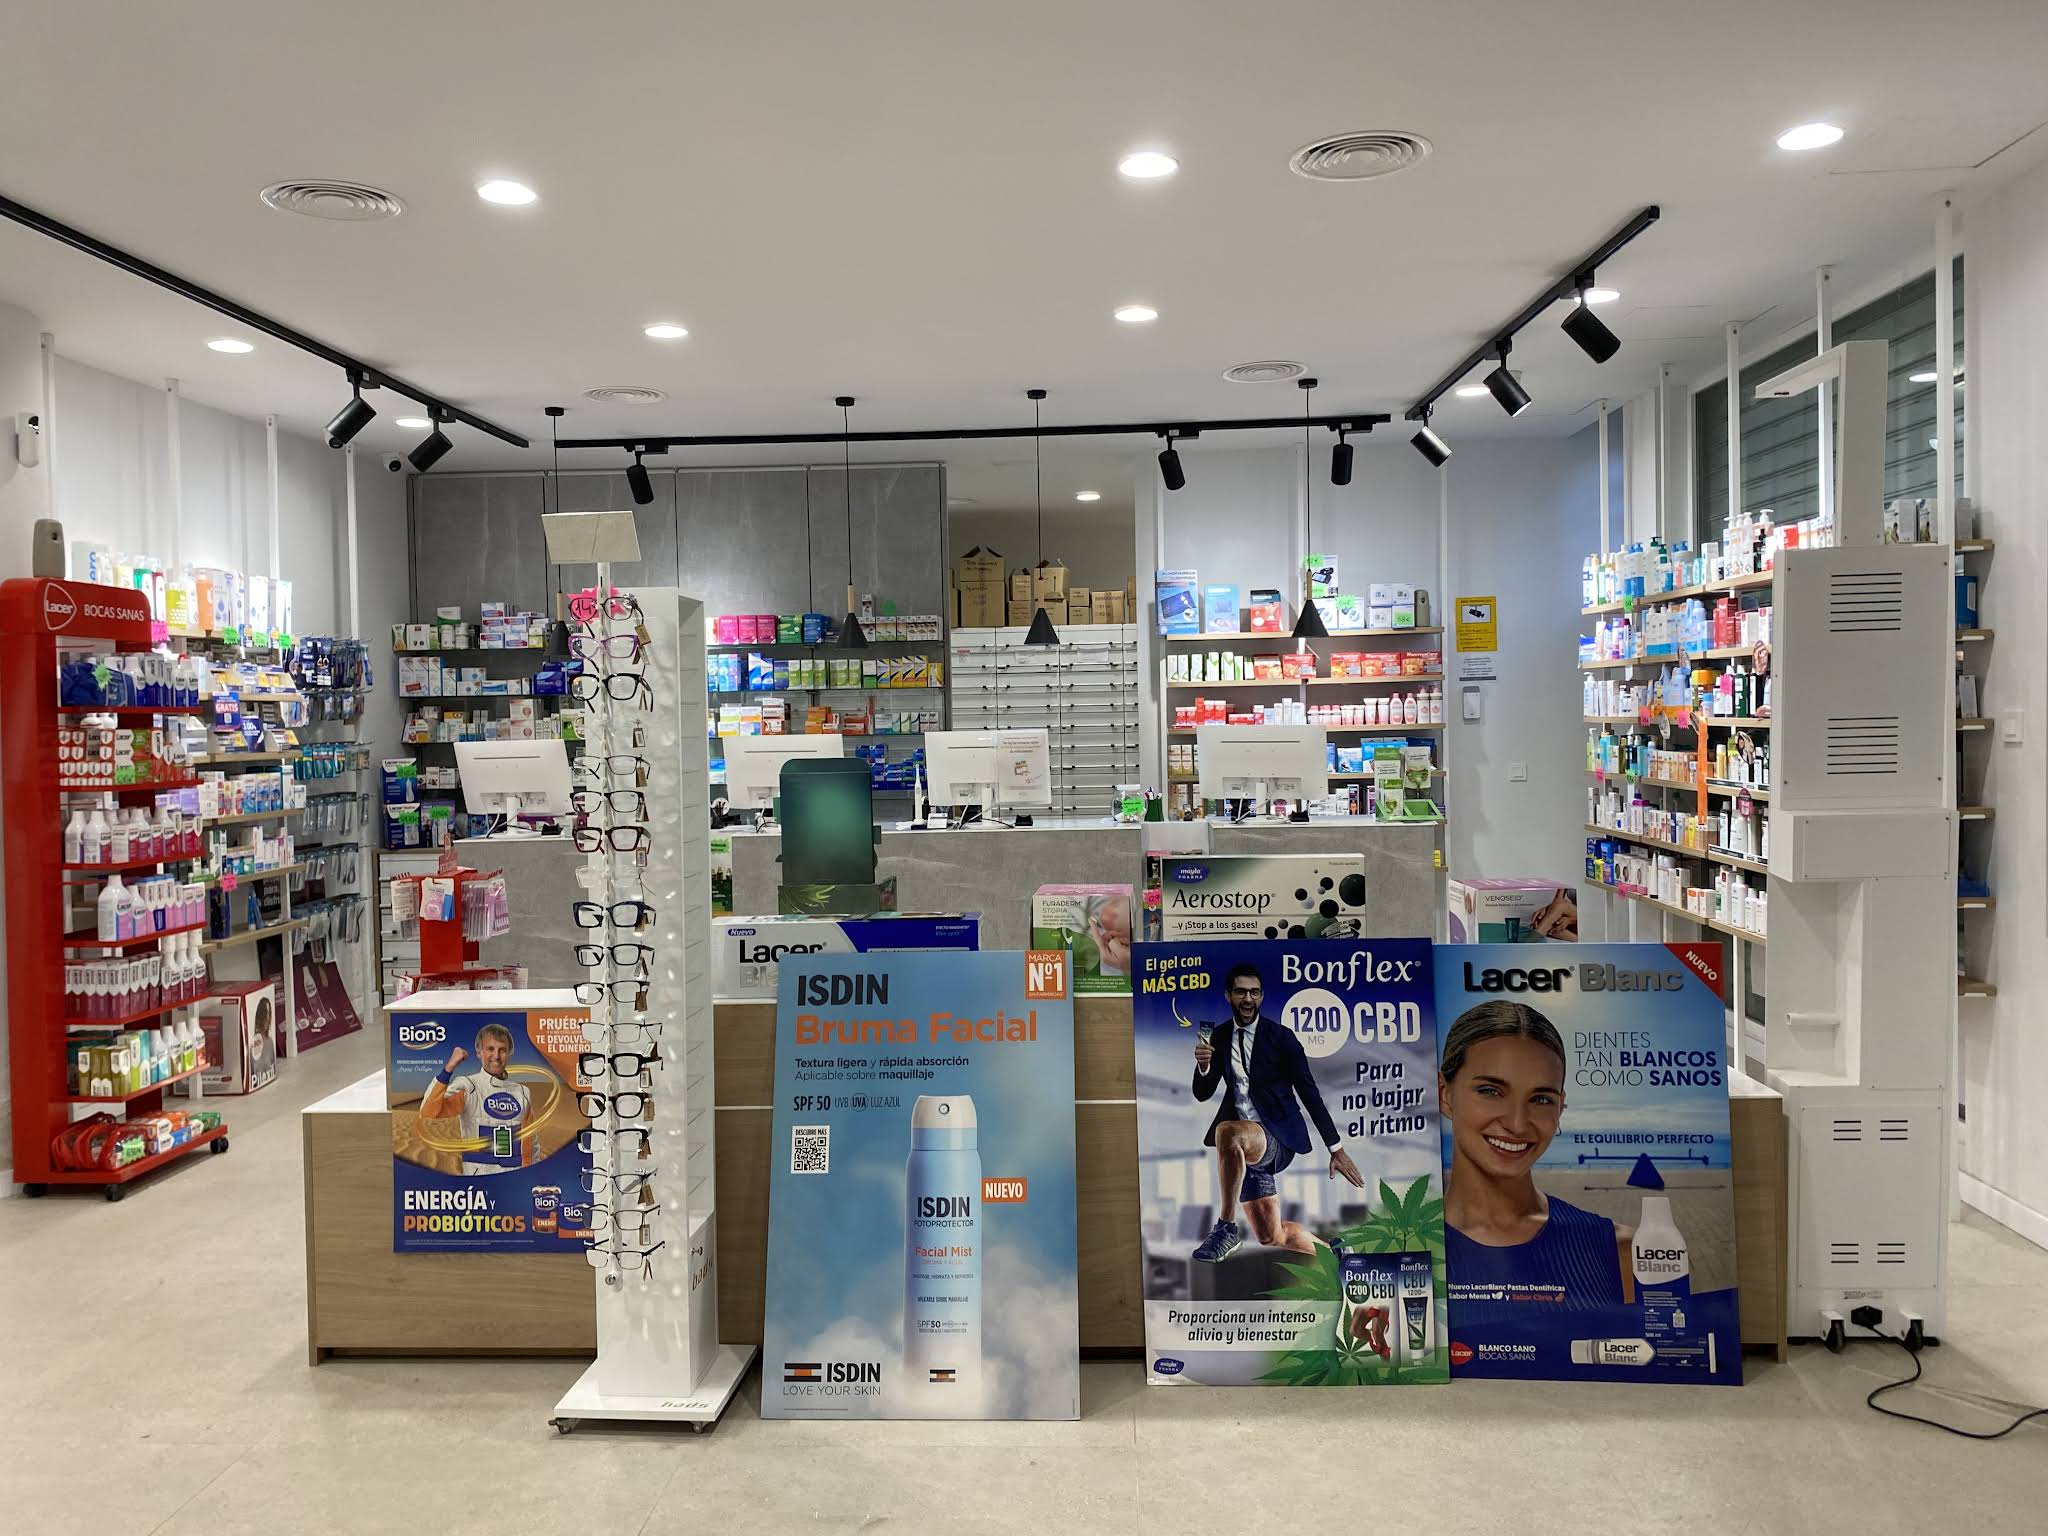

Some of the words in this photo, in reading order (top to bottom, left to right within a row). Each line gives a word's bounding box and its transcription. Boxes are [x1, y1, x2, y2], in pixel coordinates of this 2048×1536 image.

[46, 600, 74, 614] Lacer
[84, 604, 115, 619] BOCAS
[116, 609, 145, 621] SANAS
[215, 703, 239, 713] GRATIS
[1172, 889, 1271, 914] Aerostop
[730, 928, 754, 936] Nuevo
[1185, 921, 1207, 930] ¡Stop
[1216, 921, 1228, 929] los
[1231, 921, 1258, 930] gases!
[1028, 954, 1063, 962] MARCA
[1145, 958, 1157, 972] El
[1159, 956, 1178, 973] gel
[1180, 955, 1202, 968] con
[1685, 950, 1719, 982] NUEVO
[1282, 951, 1414, 991] Bonflex
[1463, 961, 1571, 993] Lacer
[1579, 963, 1685, 993] Blanc
[797, 973, 889, 1006] ISDIN
[1142, 973, 1177, 994] MÁS
[1179, 972, 1211, 991] CBD
[795, 1013, 918, 1045] Bruma
[930, 1009, 1038, 1043] Facial
[1291, 1006, 1342, 1033] 1200
[1353, 1001, 1422, 1045] CBD
[399, 1025, 447, 1042] Bion3
[535, 1034, 546, 1044] TE
[1307, 1035, 1326, 1046] MG
[1574, 1031, 1651, 1049] DIENTES
[547, 1044, 558, 1053] EL
[559, 1043, 591, 1053] DINERO
[795, 1058, 834, 1069] Textura
[837, 1057, 867, 1070] ligera
[870, 1059, 876, 1070] y
[879, 1056, 914, 1072] rápida
[916, 1056, 970, 1067] absorción
[1574, 1051, 1613, 1067] TAN
[1620, 1050, 1718, 1067] BLANCOS
[794, 1070, 844, 1083] Aplicable
[846, 1071, 876, 1081] sobre
[878, 1069, 935, 1081] maquillaje
[1356, 1061, 1405, 1083] Para
[1575, 1069, 1643, 1087] COMO
[1649, 1070, 1722, 1087] SANOS
[487, 1099, 519, 1112] Bion3
[793, 1096, 814, 1111] SPF
[816, 1095, 831, 1111] 50
[852, 1097, 867, 1108] UVA
[1342, 1093, 1367, 1111] no
[1371, 1084, 1425, 1112] bajar
[1348, 1117, 1365, 1138] el
[1370, 1112, 1426, 1136] ritmo
[1574, 1134, 1587, 1144] EL
[1588, 1134, 1655, 1144] EQUILIBRIO
[1656, 1134, 1714, 1144] PERFECTO
[985, 1182, 1024, 1199] NUEVO
[563, 1206, 583, 1217] Bio
[917, 1196, 971, 1218] ISDIN
[404, 1209, 526, 1233] PROBIÓTICOS
[913, 1219, 974, 1228] FOTOPROTECTOR
[915, 1246, 948, 1257] Facial
[951, 1246, 973, 1257] Mist
[1636, 1246, 1685, 1260] Lacer
[1400, 1263, 1429, 1272] Bonflex
[1637, 1260, 1682, 1273] Blanc
[1345, 1269, 1394, 1283] Bonflex
[1404, 1273, 1426, 1289] CBD
[1348, 1285, 1368, 1296] 1200
[1371, 1283, 1395, 1299] CBD
[1448, 1283, 1471, 1291] Nuevo
[1168, 1310, 1247, 1326] Proporciona
[1249, 1313, 1266, 1324] un
[1268, 1309, 1316, 1324] intenso
[1187, 1327, 1223, 1342] alivio
[1225, 1330, 1234, 1345] y
[1237, 1328, 1298, 1342] bienestar
[1451, 1349, 1472, 1357] Lacer
[1478, 1344, 1511, 1353] BLANCO
[1513, 1345, 1536, 1353] SANO
[1604, 1342, 1639, 1353] Lacer
[1478, 1352, 1507, 1360] BOCAS
[1509, 1352, 1536, 1361] SANAS
[1604, 1353, 1638, 1363] Blanc
[827, 1362, 881, 1383] ISDIN
[783, 1385, 813, 1396] LOVE
[817, 1385, 850, 1396] YOUR
[854, 1384, 881, 1396] SKIN
